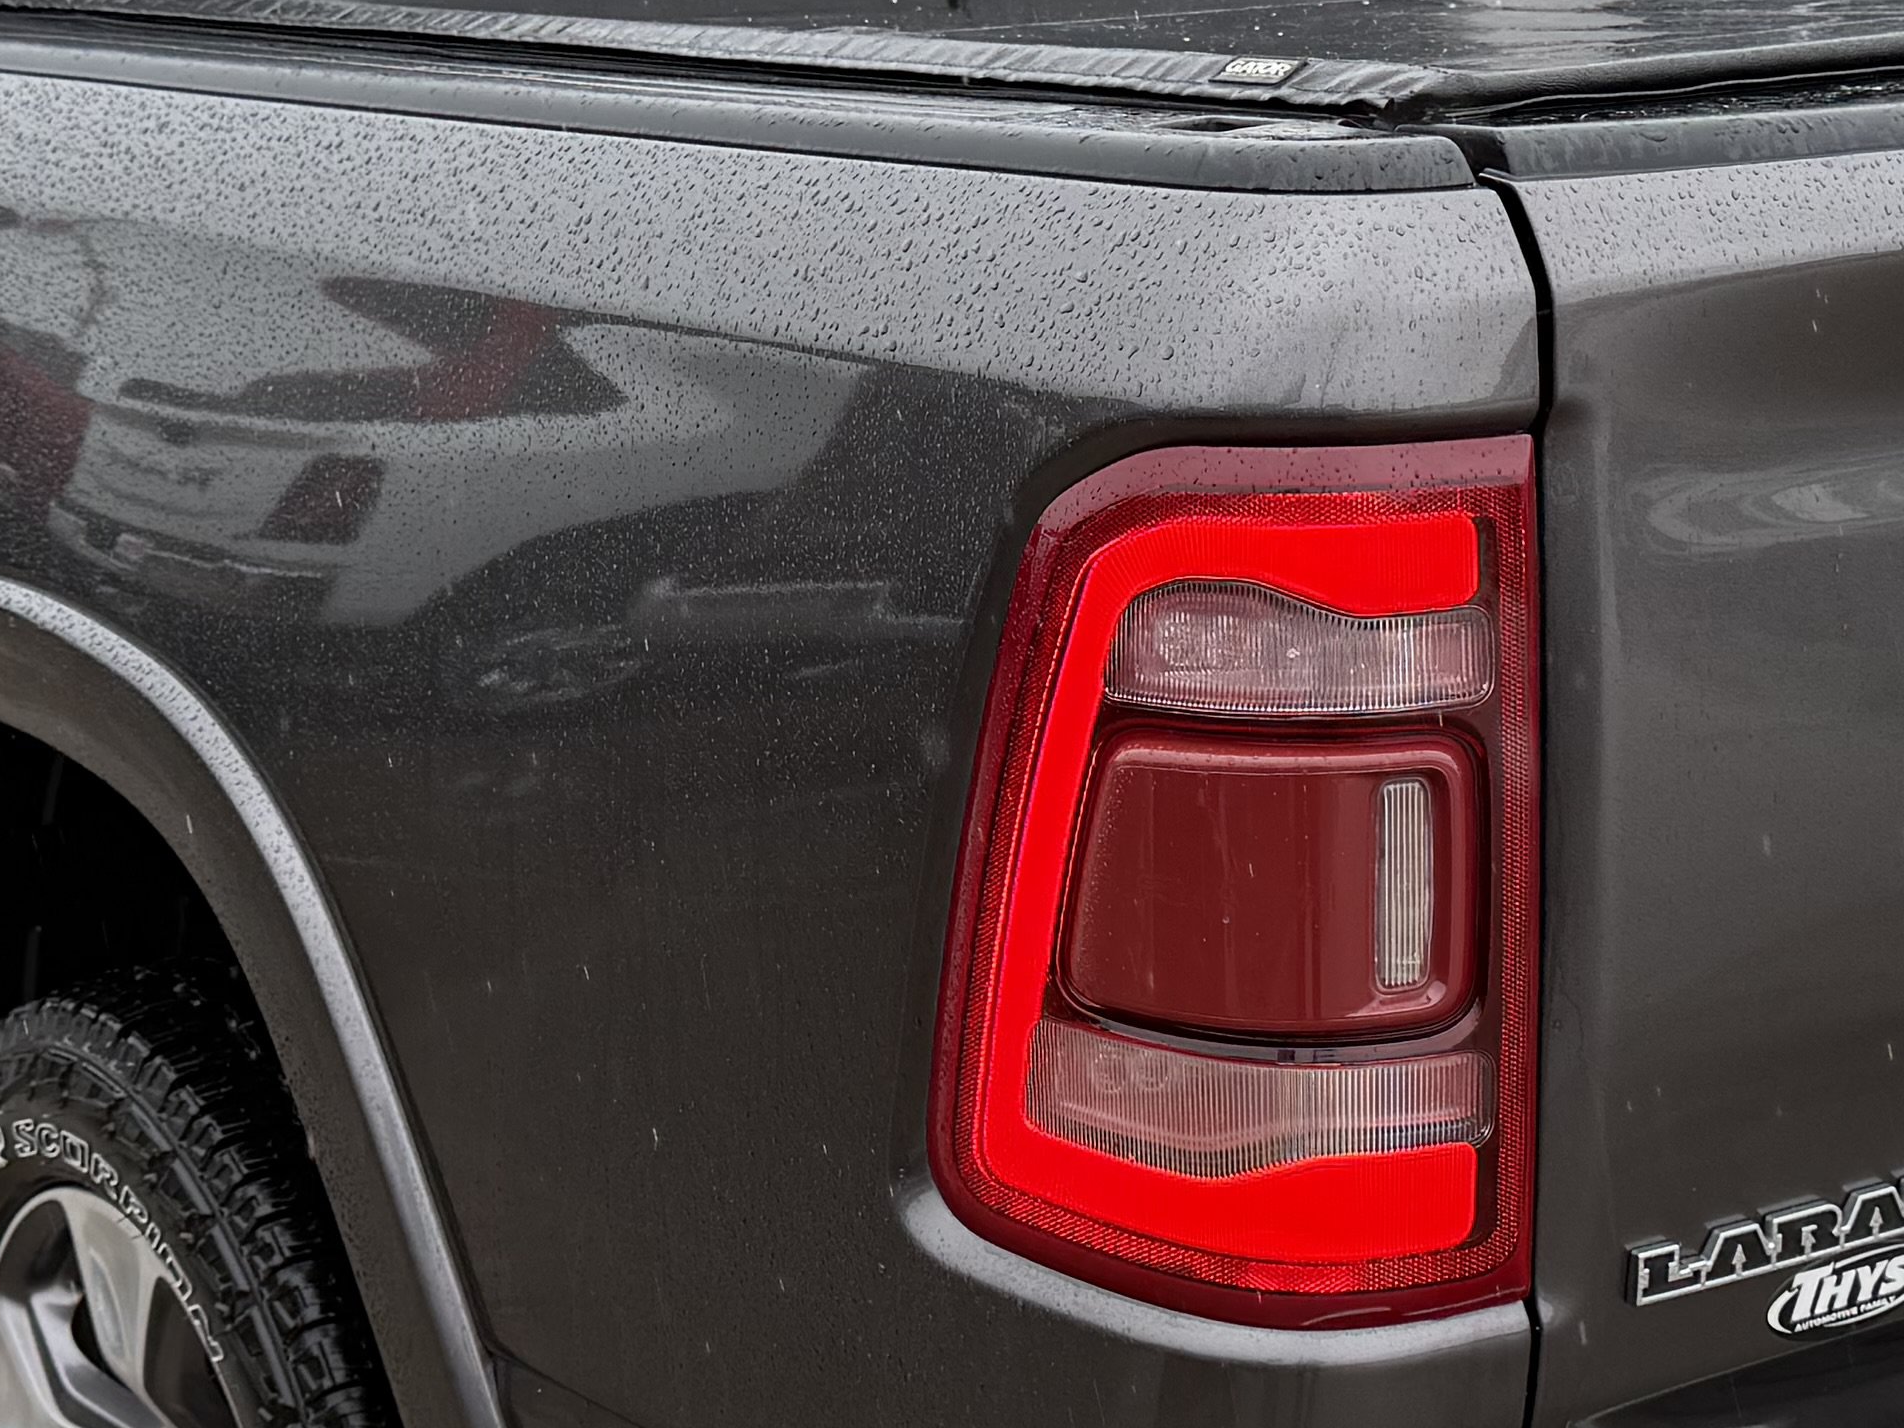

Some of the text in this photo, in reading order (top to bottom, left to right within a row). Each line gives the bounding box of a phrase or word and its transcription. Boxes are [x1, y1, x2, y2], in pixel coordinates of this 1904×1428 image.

[1225, 60, 1292, 77] GATOR
[12, 1118, 224, 1363] SCORPION
[1794, 1305, 1858, 1332] AUTOMOTIVE
